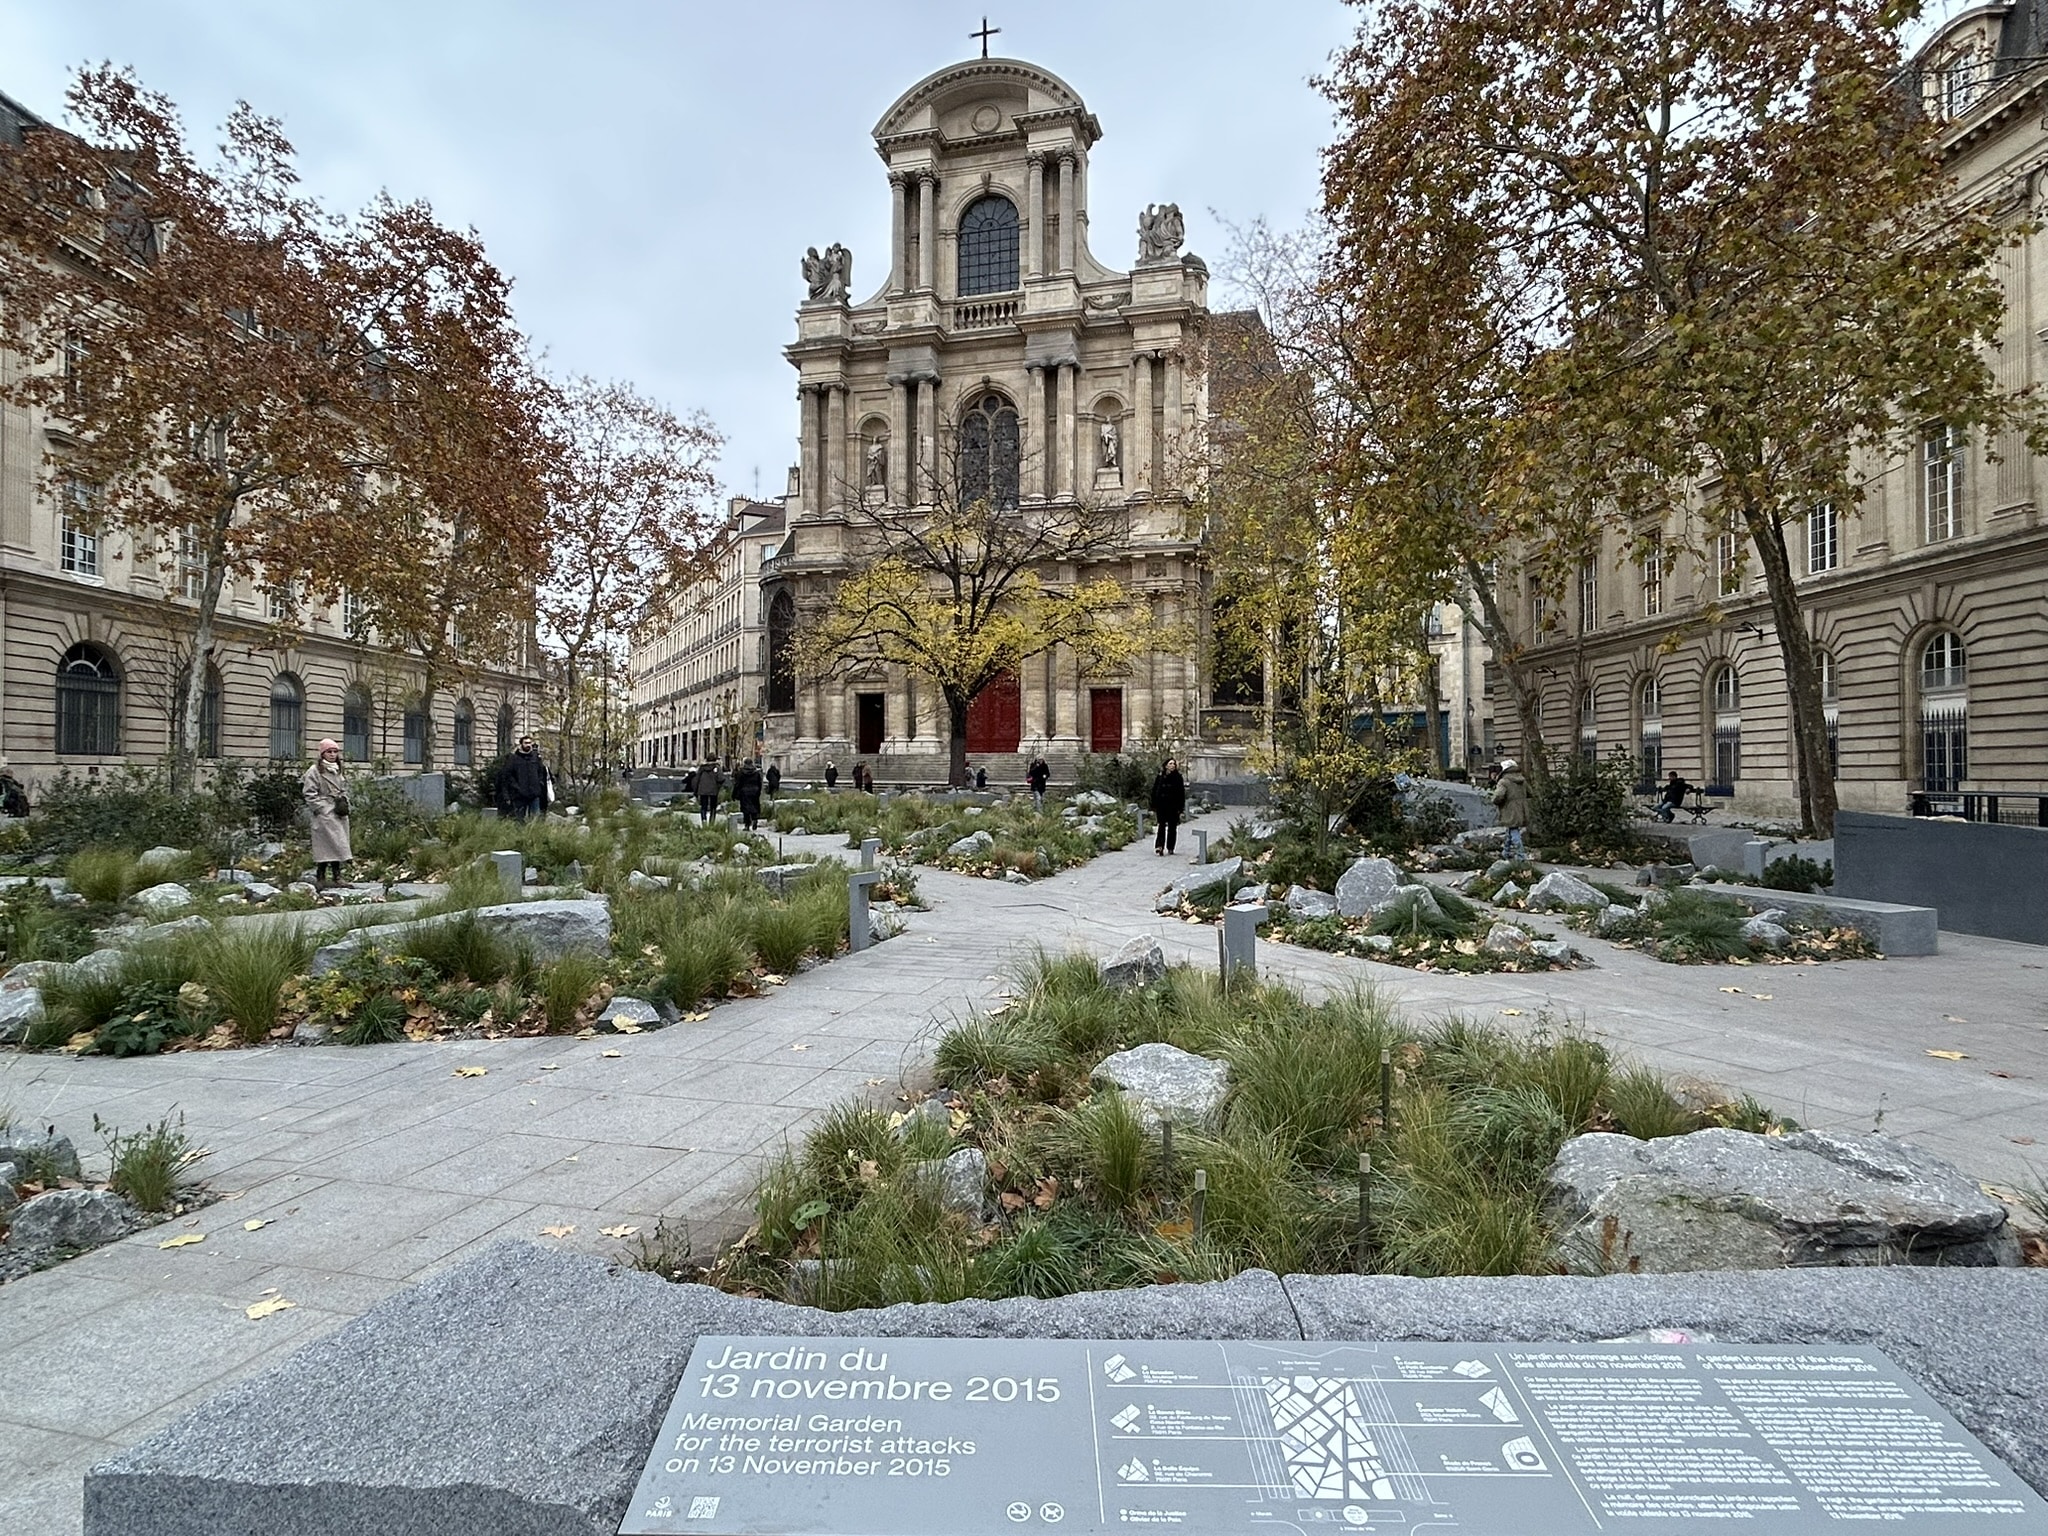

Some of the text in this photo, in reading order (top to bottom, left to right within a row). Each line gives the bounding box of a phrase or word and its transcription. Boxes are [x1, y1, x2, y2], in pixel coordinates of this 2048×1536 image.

[706, 1345, 888, 1371] Jardin du
[1514, 1359, 1534, 1368] des
[1609, 1360, 1660, 1369] novembre
[1524, 1352, 1554, 1361] jardin
[1568, 1353, 1620, 1362] hommage
[1696, 1354, 1706, 1363] A
[1740, 1354, 1753, 1362] in
[1753, 1356, 1798, 1364] memory
[1807, 1355, 1826, 1363] the
[1702, 1362, 1713, 1370] of
[1711, 1361, 1733, 1369] the
[1733, 1362, 1772, 1370] attacks
[1784, 1362, 1798, 1370] 13
[1796, 1363, 1850, 1371] November
[699, 1373, 1061, 1403] 13 novembre 2015
[681, 1412, 902, 1433] Memorial Garden
[674, 1432, 976, 1456] for the terrorist attacks
[665, 1455, 951, 1477] on 13 November 2015
